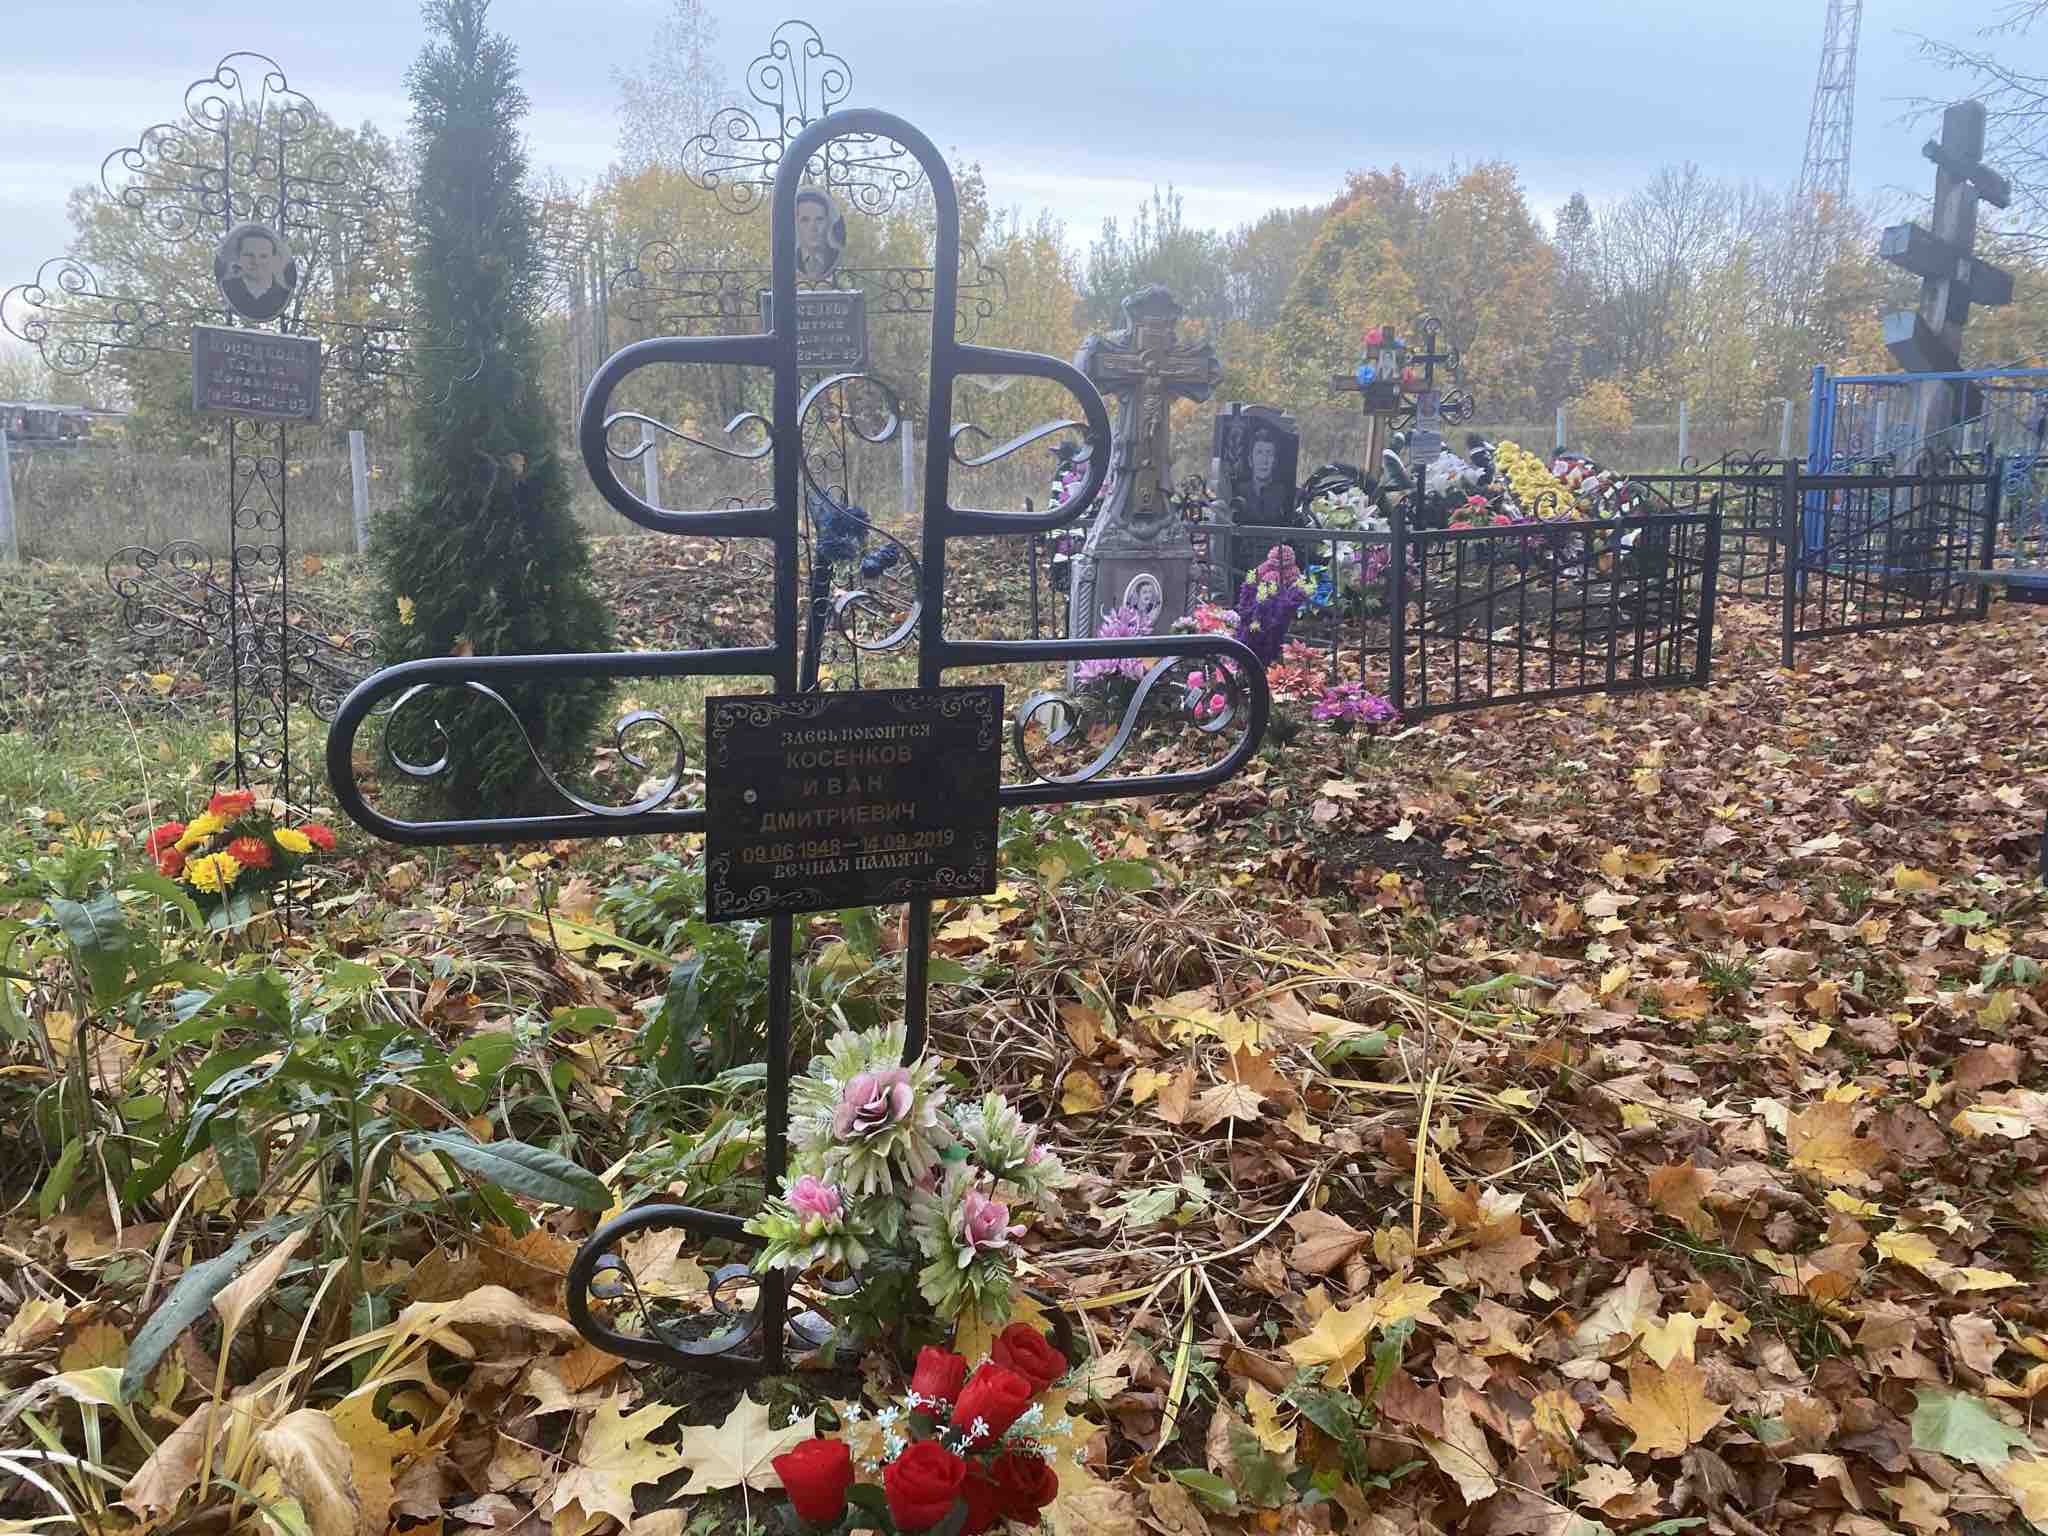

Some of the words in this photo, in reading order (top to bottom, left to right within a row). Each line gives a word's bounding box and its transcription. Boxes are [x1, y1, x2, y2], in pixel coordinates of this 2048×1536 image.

[786, 746, 913, 769] КОСЕНКОВ
[803, 775, 883, 796] ИВАН
[760, 802, 916, 833] ДМИТРИЕВИЧ
